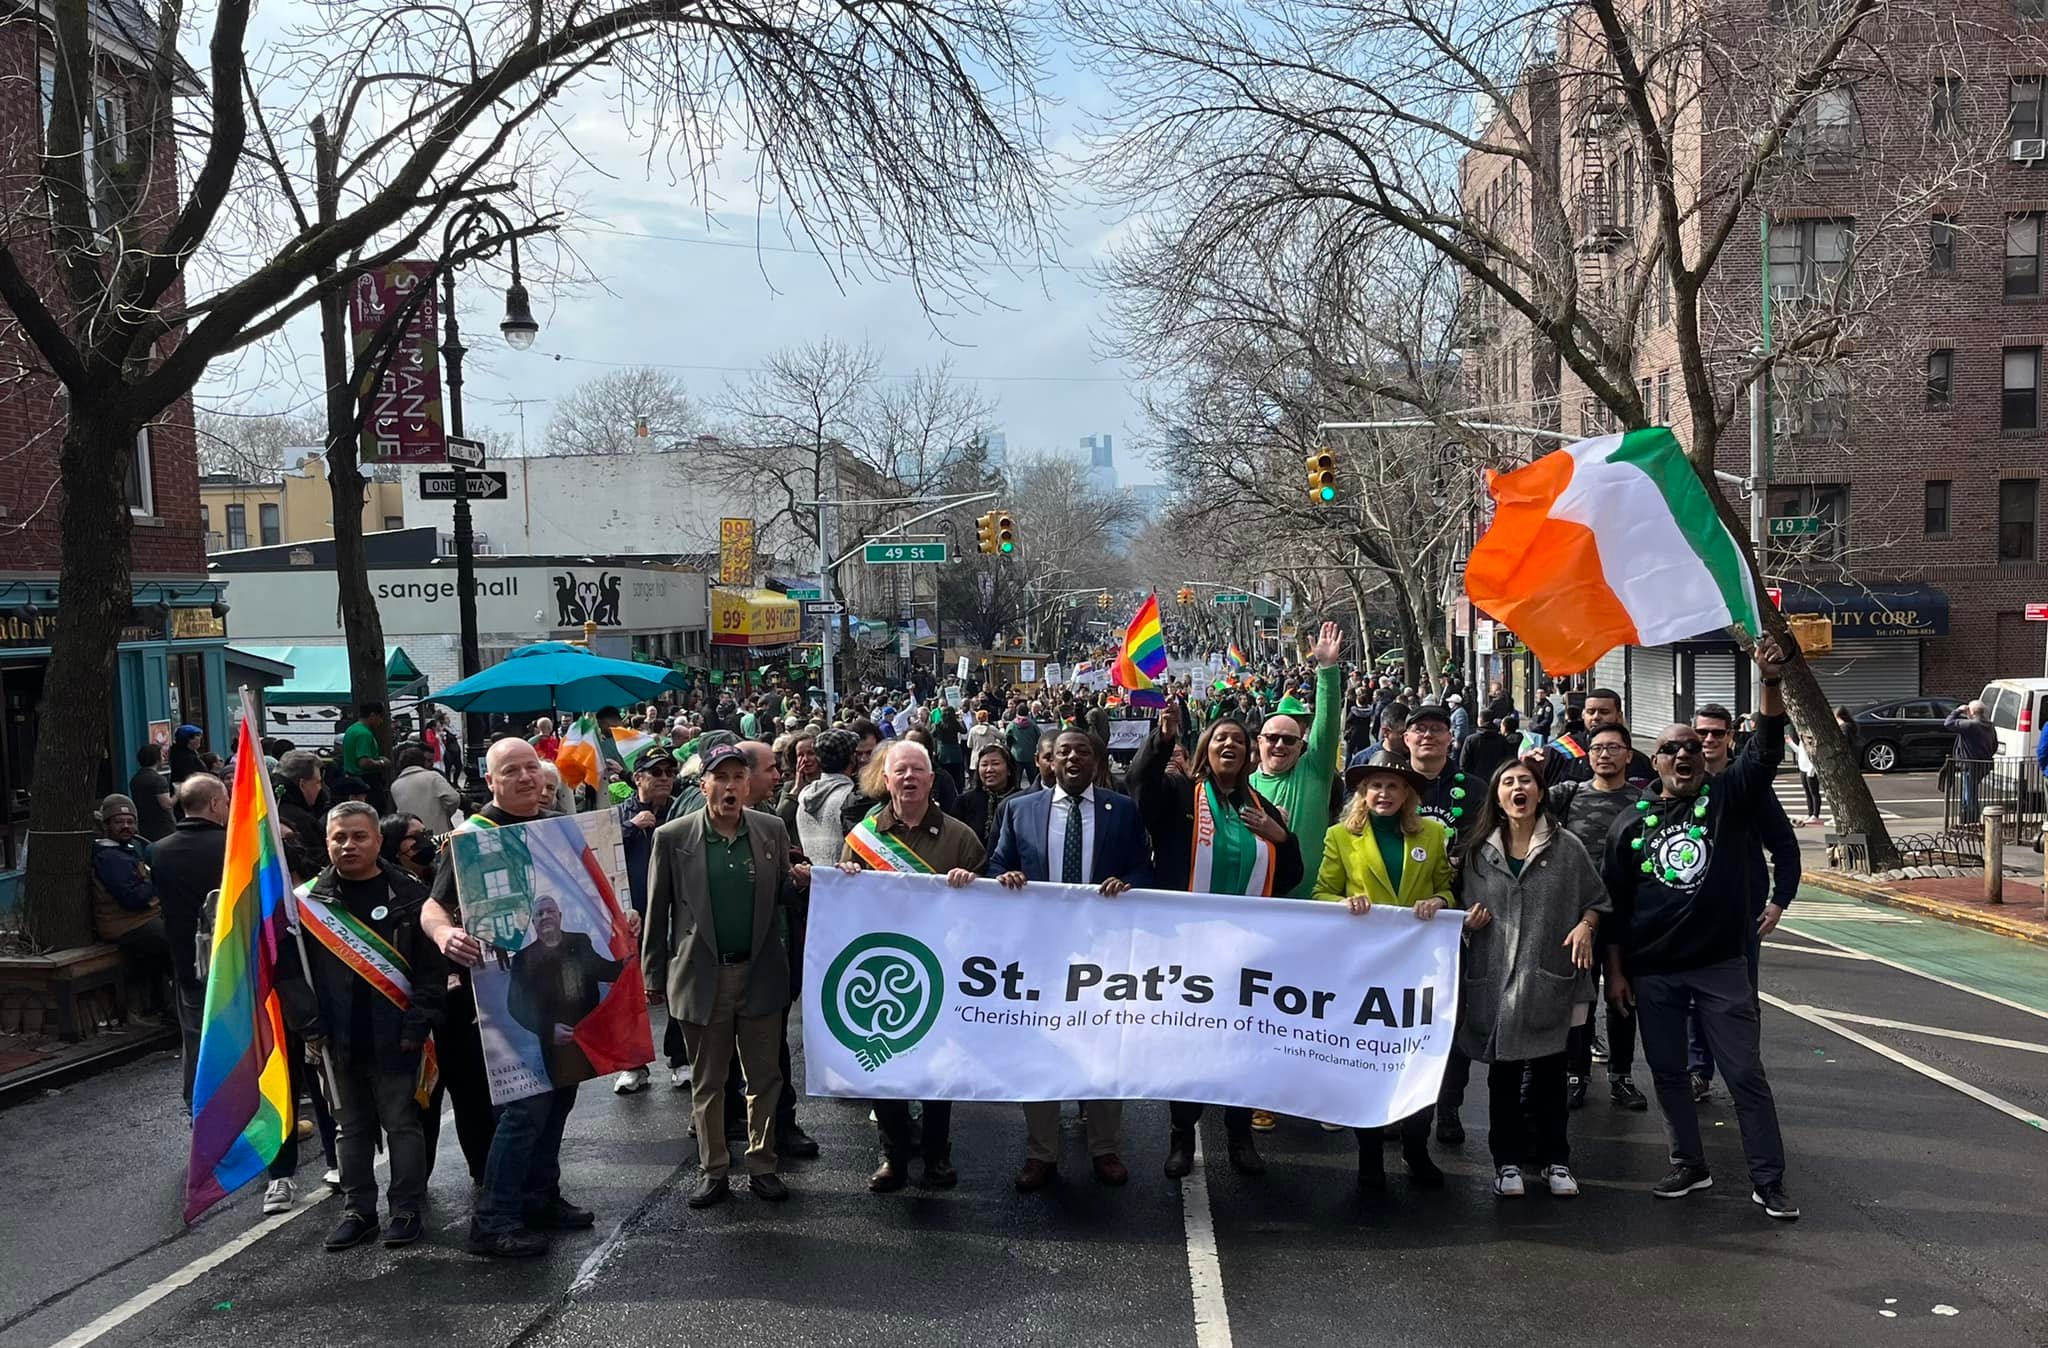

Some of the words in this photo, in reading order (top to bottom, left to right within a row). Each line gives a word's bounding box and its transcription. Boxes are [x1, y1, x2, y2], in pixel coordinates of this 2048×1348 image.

[451, 445, 465, 458] ONE
[468, 449, 480, 459] WAY
[432, 480, 456, 492] ONE
[467, 480, 493, 492] WAY
[1776, 520, 1794, 534] 49
[885, 548, 904, 559] 49
[910, 548, 926, 559] St
[473, 576, 519, 597] hall
[1869, 610, 1921, 626] CORP.
[958, 956, 1041, 1001] St.
[1064, 964, 1214, 1004] Pat's
[1238, 967, 1336, 1019] For
[1353, 986, 1434, 1028] All
[1066, 1010, 1086, 1026] all
[1095, 1009, 1112, 1026] of
[1115, 1010, 1145, 1025] the
[1150, 1010, 1228, 1030] children
[1233, 1016, 1254, 1032] of
[1258, 1018, 1287, 1038] the
[1293, 1027, 1351, 1049] nation
[1283, 1044, 1307, 1059] Irish
[1308, 1048, 1379, 1073] Proclamation,
[1382, 1062, 1406, 1073] 1916
